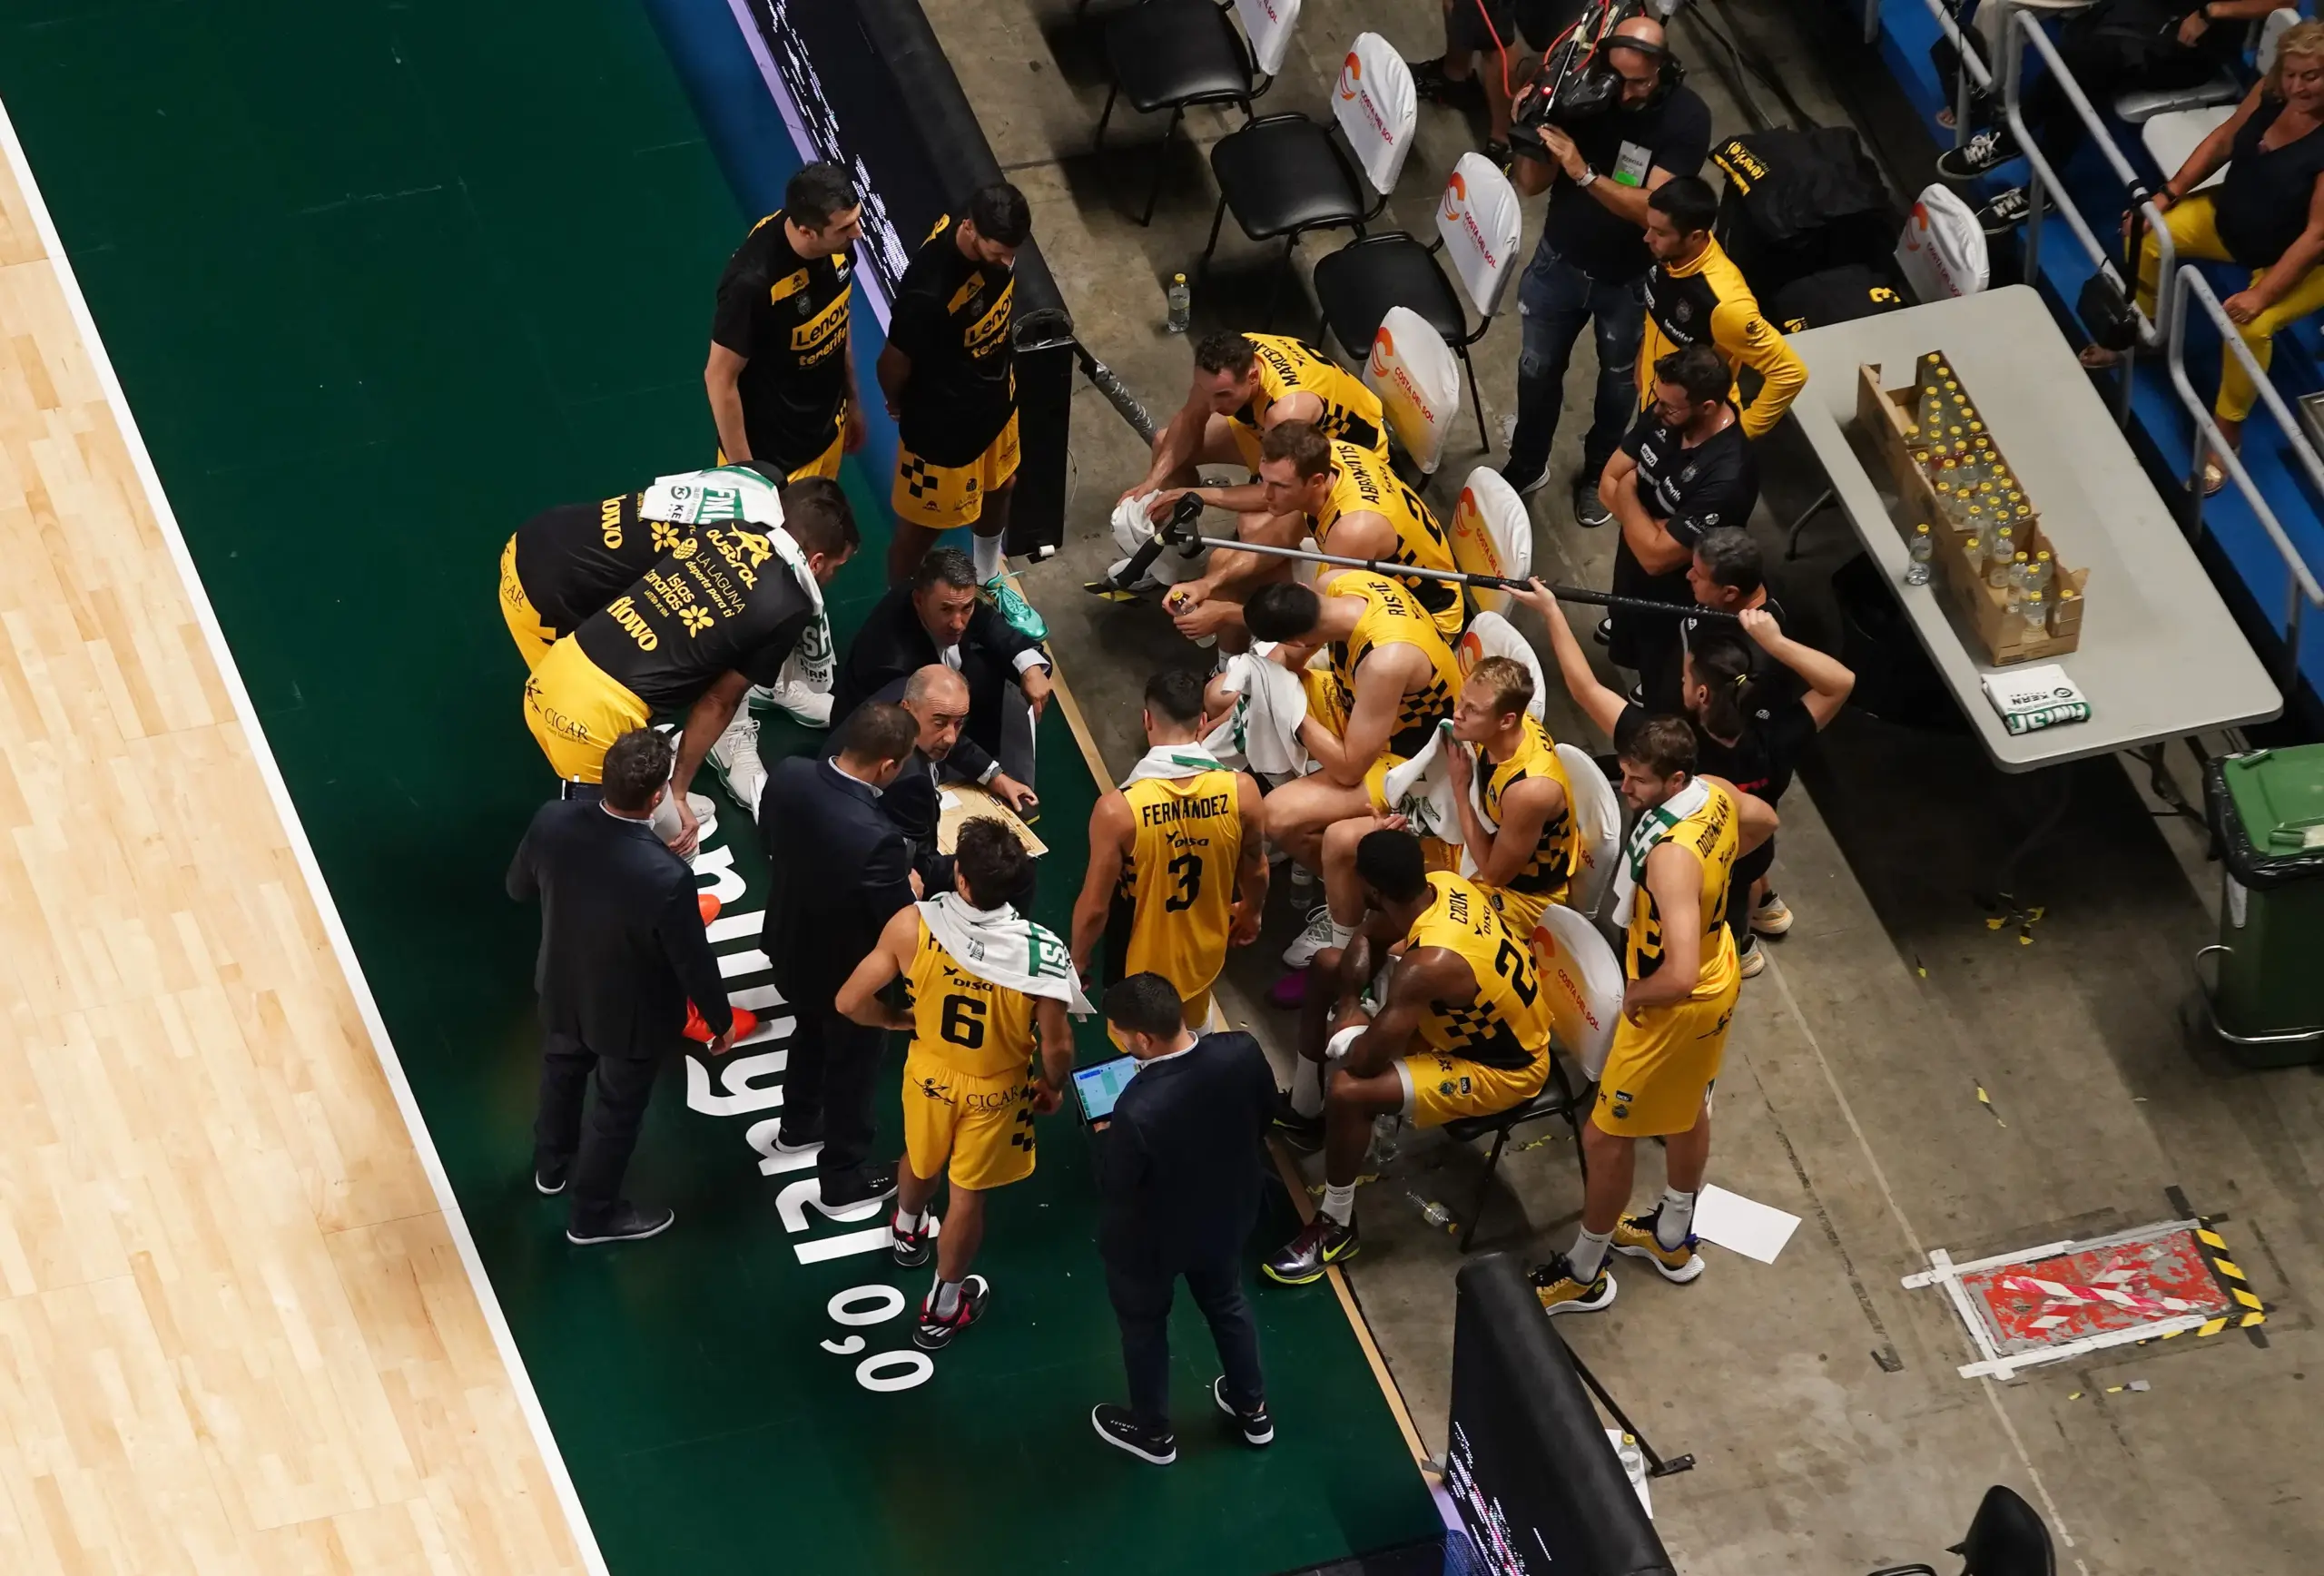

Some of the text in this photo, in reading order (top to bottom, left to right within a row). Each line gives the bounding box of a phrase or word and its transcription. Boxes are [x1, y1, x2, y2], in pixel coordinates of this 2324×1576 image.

[1381, 127, 1393, 145] SOL
[1483, 250, 1497, 269] SOL
[1394, 366, 1435, 425] COSTA DEL SOL
[1476, 527, 1491, 556] COSTA
[1488, 552, 1498, 572] DEL
[666, 572, 695, 604] Islas
[684, 559, 712, 589] deporte
[705, 586, 727, 609] para
[723, 606, 735, 618] ti
[695, 551, 746, 614] LA LAGUNA
[606, 596, 658, 652] flowo
[2011, 694, 2050, 705] KERN
[545, 707, 589, 742] CICAR
[1165, 852, 1204, 913] 3
[1581, 850, 1596, 870] SOL
[1449, 887, 1469, 925] COOK
[940, 993, 988, 1050] 6
[1558, 968, 1577, 1000] COSTA
[1585, 1010, 1600, 1031] SOL
[965, 1084, 1019, 1108] CICAR
[820, 1284, 935, 1393] 0,0
